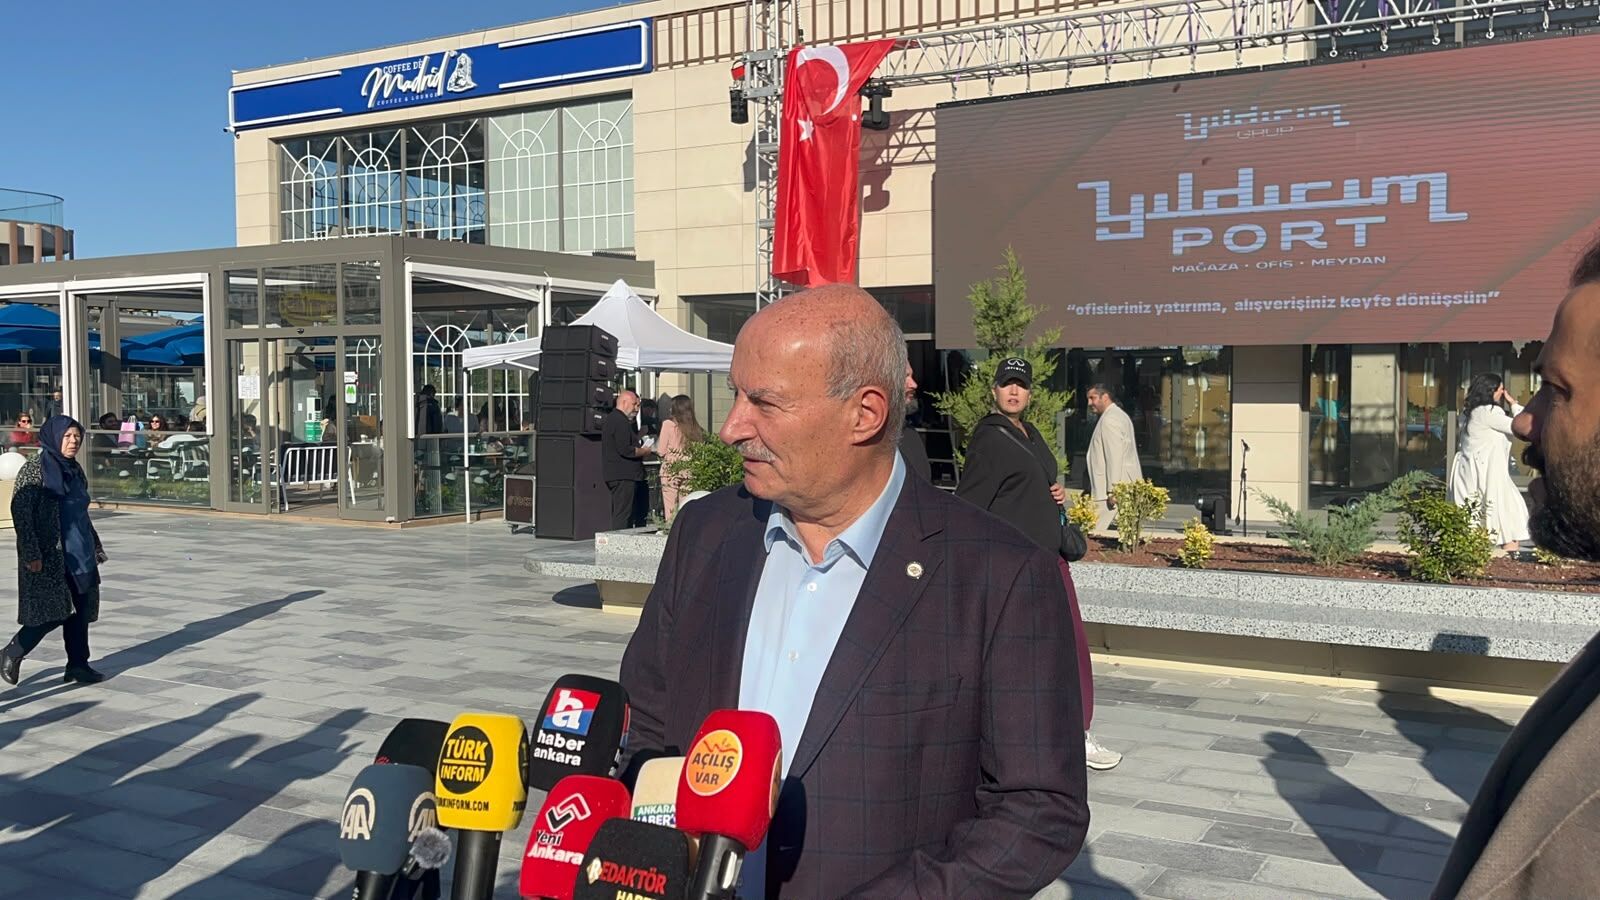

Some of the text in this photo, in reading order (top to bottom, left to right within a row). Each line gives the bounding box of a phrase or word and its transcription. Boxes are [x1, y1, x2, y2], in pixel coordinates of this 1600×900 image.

[383, 62, 412, 74] COFFEE
[361, 51, 457, 108] Madrid
[1172, 215, 1386, 255] PORT
[1172, 262, 1239, 273] MAĞAZA
[1311, 256, 1386, 267] MEYDAN
[1234, 295, 1336, 313] alışverişiniz
[1340, 295, 1391, 310] keyfe
[446, 735, 488, 761] TÜRK
[537, 729, 586, 752] haber
[533, 747, 581, 767] ankara
[691, 752, 735, 773] AÇILIŞ
[440, 764, 485, 783] INFORM
[695, 771, 720, 785] VAR
[637, 803, 676, 816] ANKARA
[536, 830, 564, 846] Yeni
[527, 841, 584, 866] Ankara
